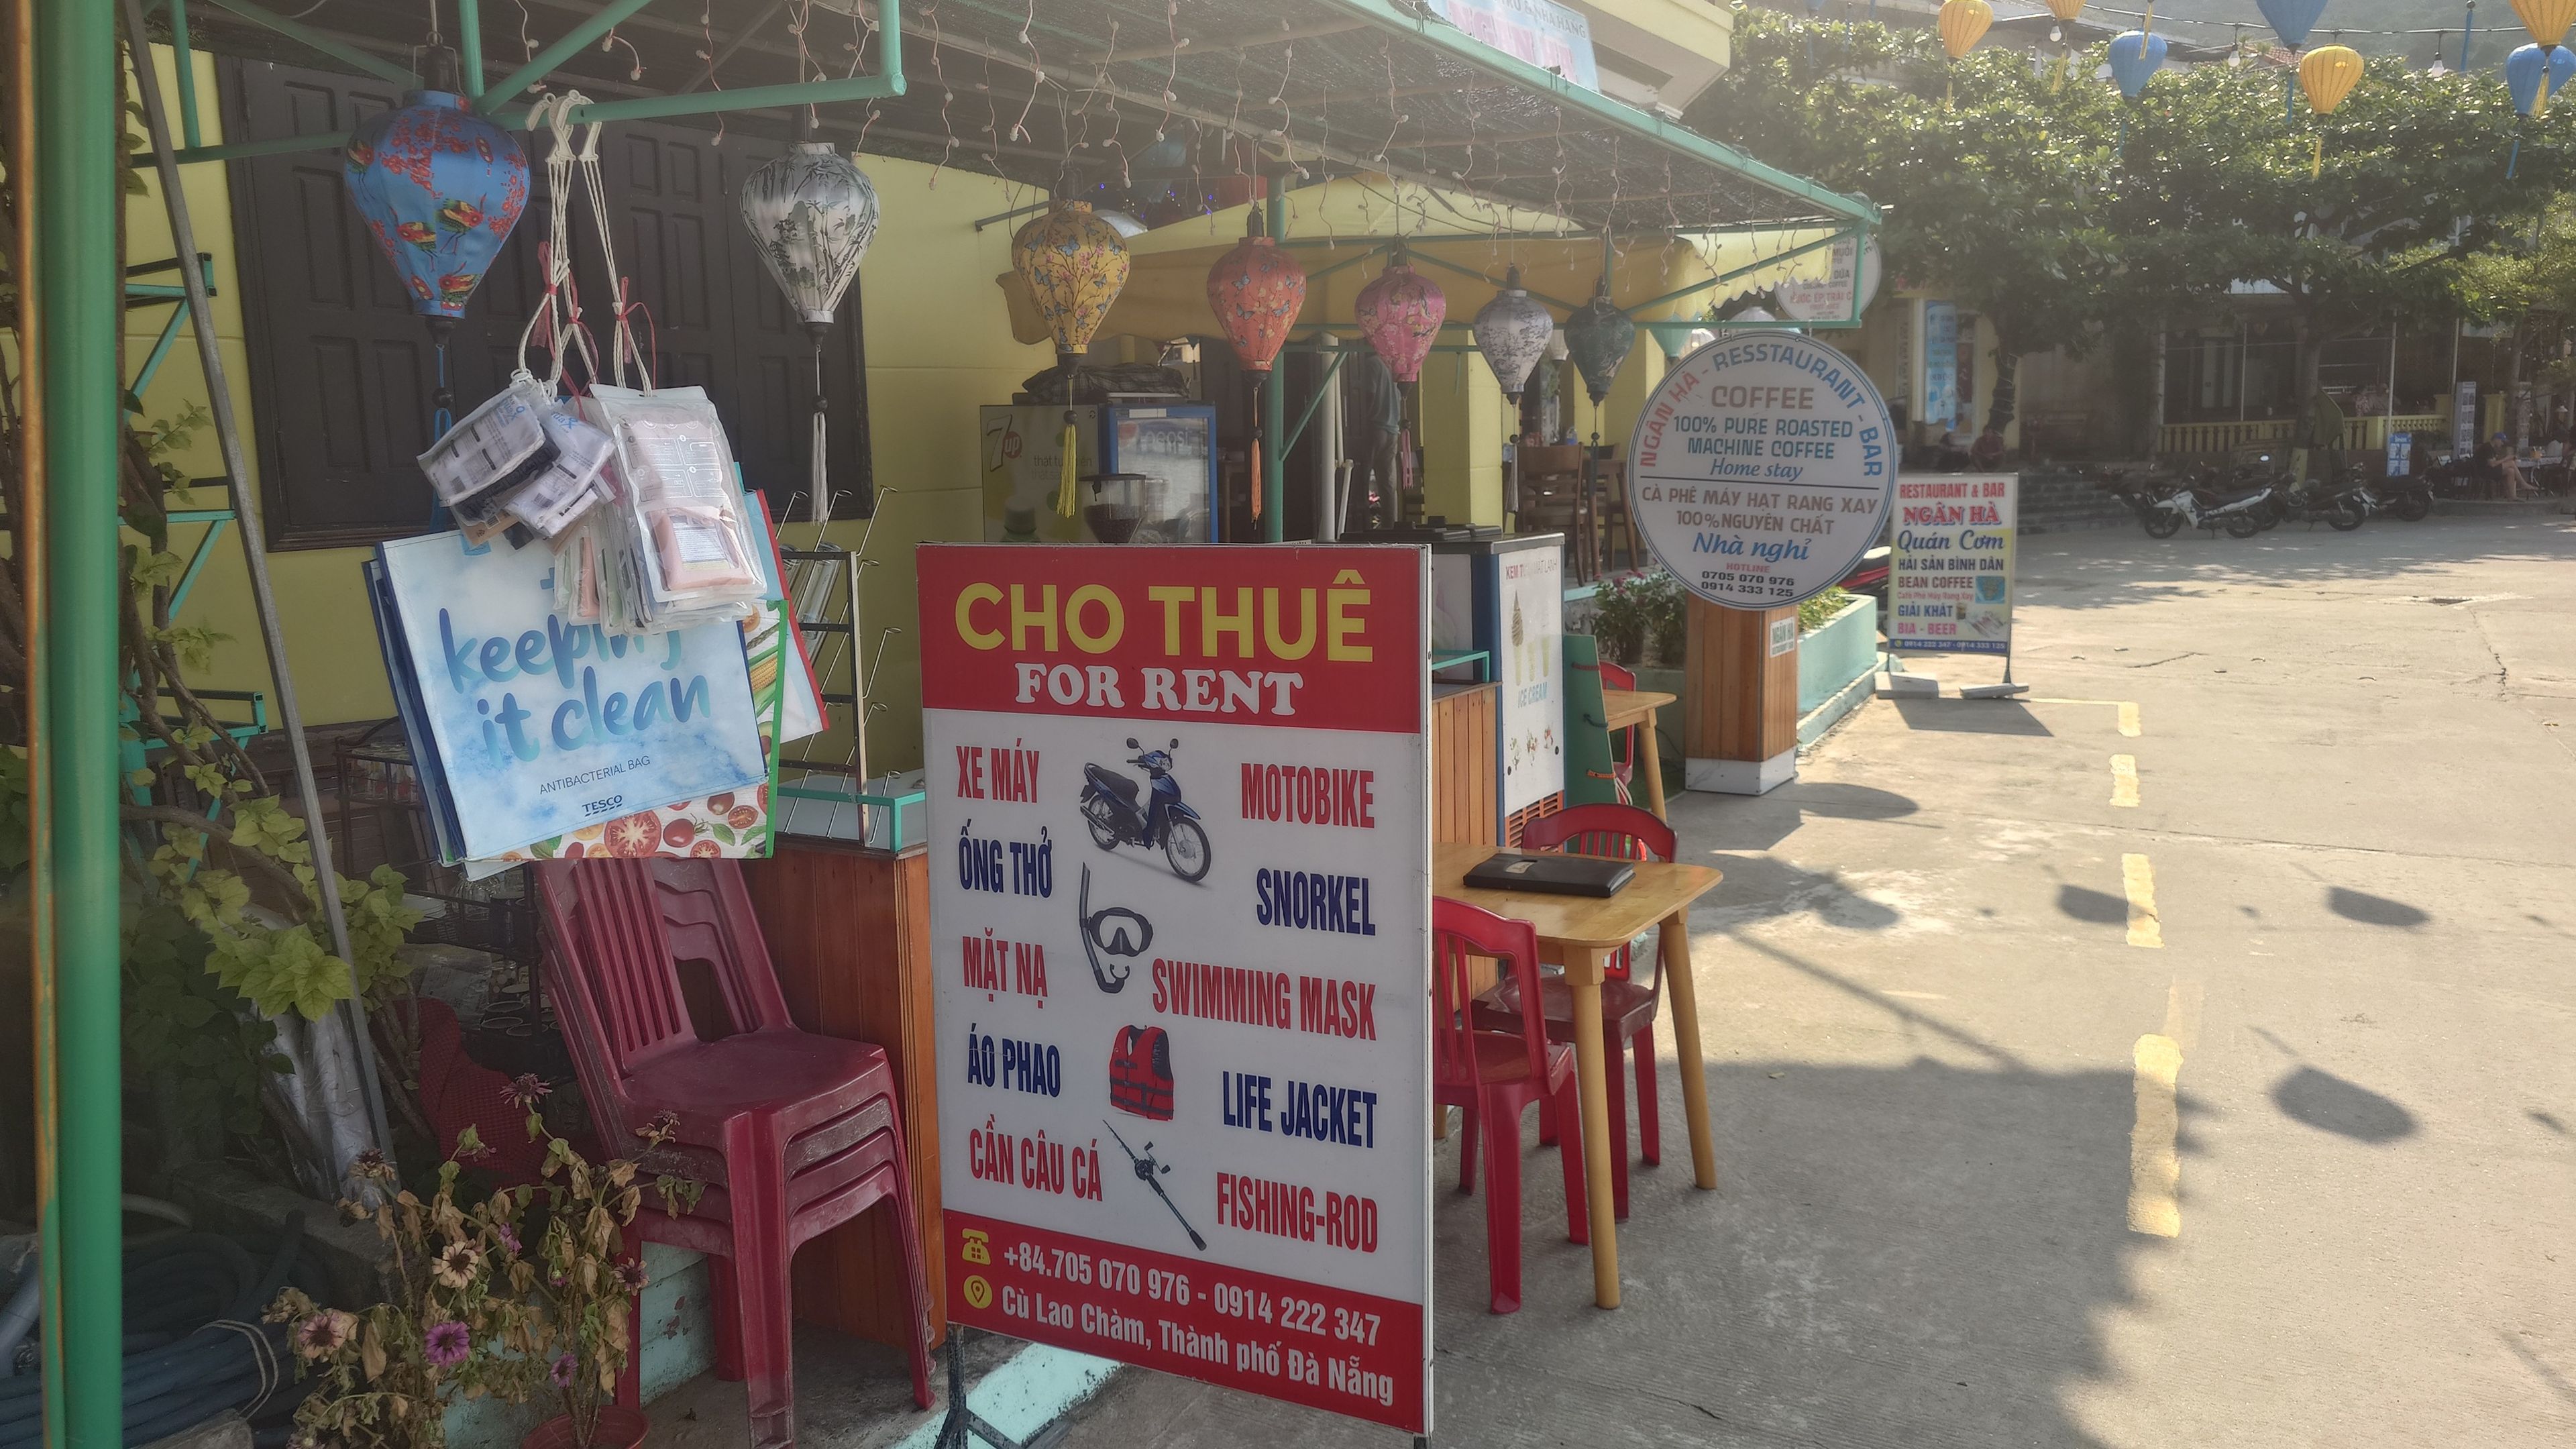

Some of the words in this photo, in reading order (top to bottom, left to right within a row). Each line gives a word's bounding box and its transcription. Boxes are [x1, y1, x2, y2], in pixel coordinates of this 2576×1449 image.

[1640, 401, 1675, 468] NGÂN
[1668, 370, 1700, 402] HÀ
[1712, 343, 1866, 410] RESSTAURANT
[1859, 426, 1882, 477] BAR
[1711, 385, 1815, 411] COFFEE
[1674, 416, 1717, 434] 100%
[1725, 418, 1768, 436] PURE
[1776, 419, 1854, 438] ROASTED
[1688, 437, 1764, 457] MACHINE
[1771, 440, 1835, 460] COFFEE
[1710, 458, 1760, 478] Home
[1764, 463, 1804, 482] stay
[1642, 484, 1663, 502] CÀ
[1668, 486, 1698, 504] PHÊ
[1703, 485, 1741, 507] MÁY
[1747, 492, 1781, 514] HẠT
[1787, 494, 1834, 513] RANG
[1841, 498, 1878, 515] XAY
[1900, 483, 1968, 499] RESTAURANT
[1971, 484, 1979, 498] &
[1982, 482, 2005, 498] BAR
[1790, 513, 1835, 535] CHẤT
[1902, 501, 1965, 526] NGÂN
[1968, 500, 2002, 525] HÀ
[1693, 532, 1744, 555] Nhà
[1750, 538, 1812, 563] nghỉ
[1898, 529, 1951, 553] Quán
[1959, 529, 2004, 550] Cơm
[1505, 564, 1519, 580] KEM
[1726, 563, 1771, 574] HOTLINE
[1898, 554, 1917, 570] HẢI
[1921, 554, 1944, 570] SẢN
[1947, 555, 1976, 570] BÌNH
[1979, 555, 2004, 570] DÂN
[1701, 571, 1735, 582] 0705
[1739, 574, 1764, 584] 070
[1769, 576, 1794, 587] 976
[1701, 581, 1734, 592] 0914
[1737, 584, 1764, 595] 333
[1768, 587, 1794, 598] 125
[1898, 576, 1929, 588] BEAN
[1932, 576, 1974, 589] COFFEE
[955, 582, 1125, 655] CHO
[1148, 570, 1374, 662] THUÊ
[1898, 601, 1920, 616] GIẢI
[1898, 623, 1916, 634] BIA
[1927, 623, 1957, 635] BEER
[1014, 662, 1126, 708] FOR
[1140, 666, 1304, 716] RENT
[1517, 690, 1527, 708] ICE
[1528, 682, 1548, 704] CREAM
[476, 692, 541, 769] it
[550, 665, 712, 751] clean
[539, 764, 627, 796] ANTIBACTERIAL
[627, 755, 651, 773] BAG
[956, 746, 984, 800] XE
[991, 738, 1040, 804] MÁY
[582, 794, 624, 814] TESCO
[1241, 762, 1376, 829] MOTOBIKE
[959, 818, 1004, 894] ỐNG
[1010, 826, 1053, 899] THỞ
[1256, 867, 1377, 936] SNORKEL
[962, 926, 1008, 1002] MẶT
[1016, 943, 1048, 1009] NẠ
[1152, 958, 1291, 1030] SWIMMING
[1299, 975, 1377, 1041] MASK
[967, 1022, 996, 1088] ÁO
[1002, 1038, 1061, 1098] PHAO
[1222, 1070, 1273, 1133] LIFE
[1281, 1080, 1378, 1149] JACKET
[969, 1114, 1014, 1185] CẦN
[1020, 1129, 1065, 1195] CÂU
[1073, 1138, 1104, 1203] CÁ
[1216, 1171, 1379, 1254] FISHING-ROD
[1004, 1242, 1092, 1286] +84.705
[1099, 1258, 1140, 1295] 070
[1147, 1267, 1190, 1307] 976
[1213, 1281, 1273, 1325] 0914
[1280, 1295, 1327, 1336] 222
[1334, 1309, 1381, 1347] 347
[1002, 1285, 1029, 1320] Cù
[1035, 1291, 1074, 1329] Lao
[1080, 1303, 1152, 1352] Chàm,
[1158, 1319, 1230, 1366] Thành
[1236, 1338, 1281, 1377] phố
[1287, 1347, 1320, 1387] Đà
[1328, 1355, 1395, 1407] Nẵng
